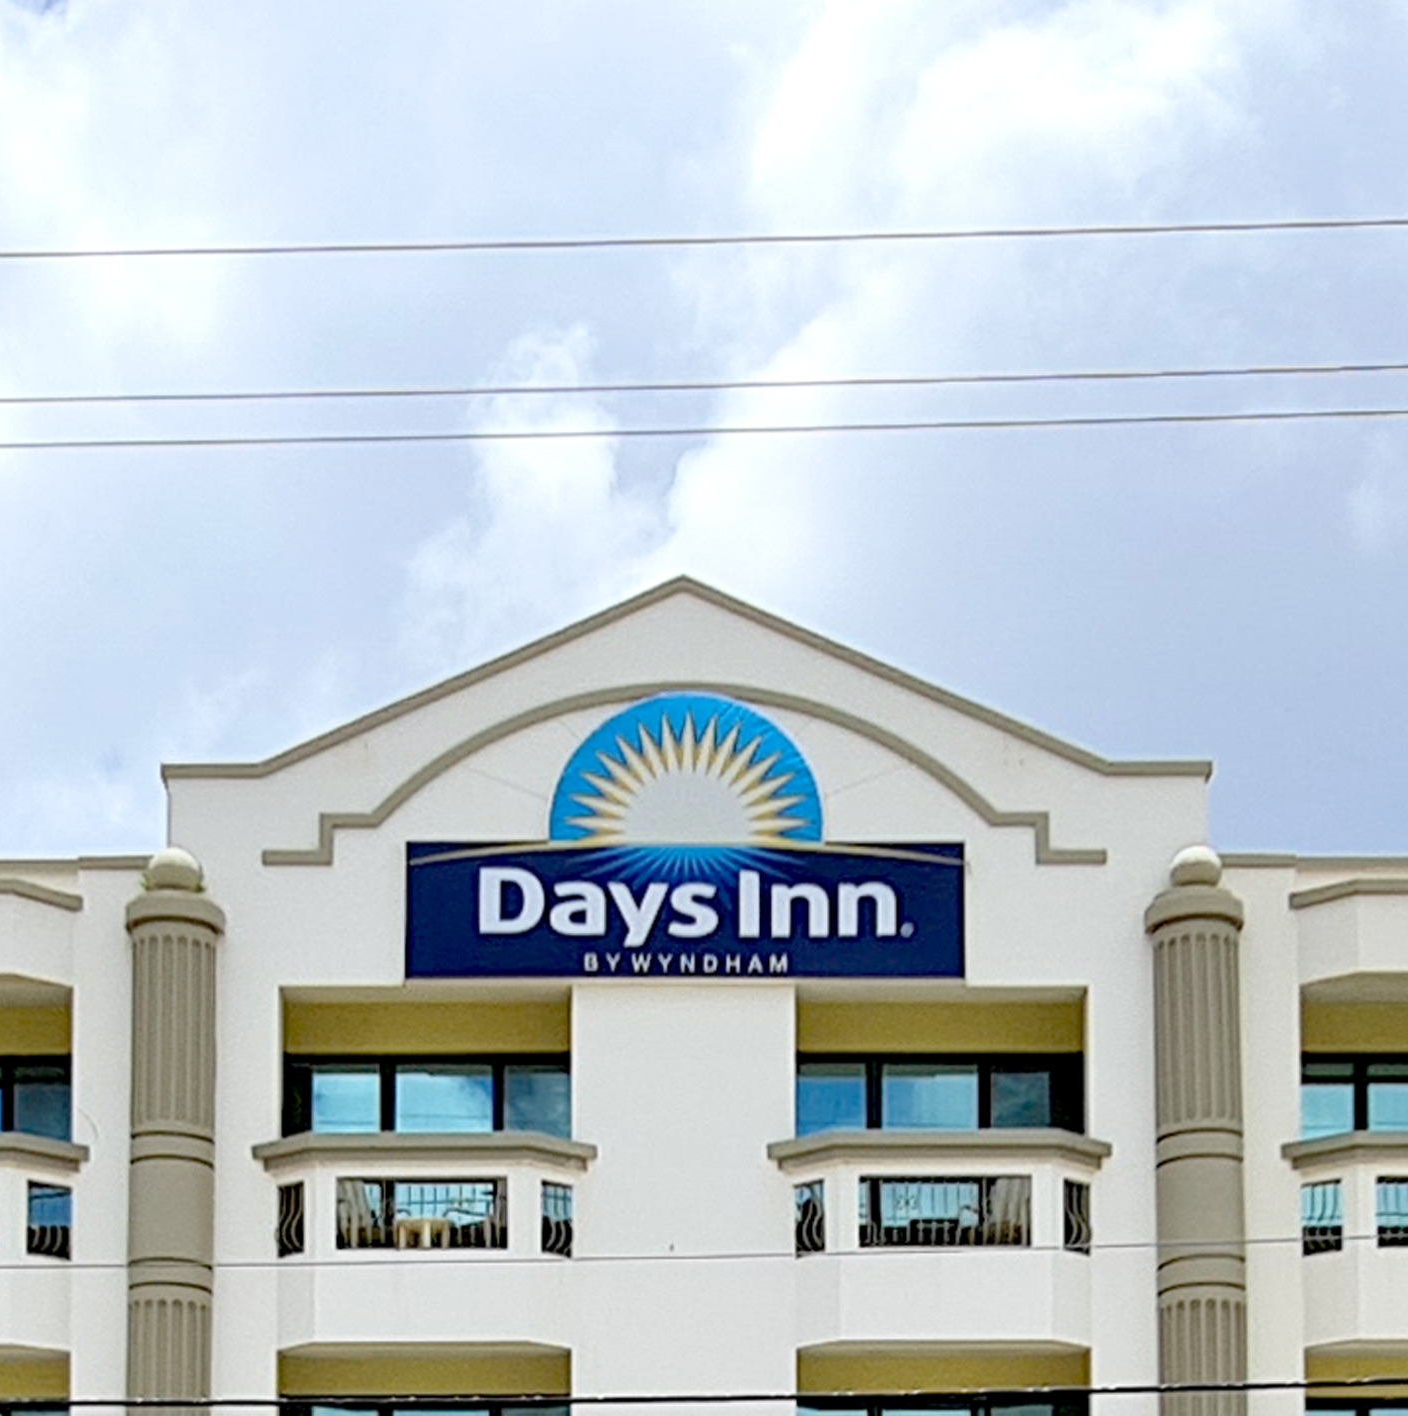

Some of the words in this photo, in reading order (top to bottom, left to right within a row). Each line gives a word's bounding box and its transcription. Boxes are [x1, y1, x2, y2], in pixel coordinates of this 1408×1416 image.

[478, 867, 719, 947] Days
[583, 953, 621, 974] BY
[632, 953, 789, 974] WYNDHAM
